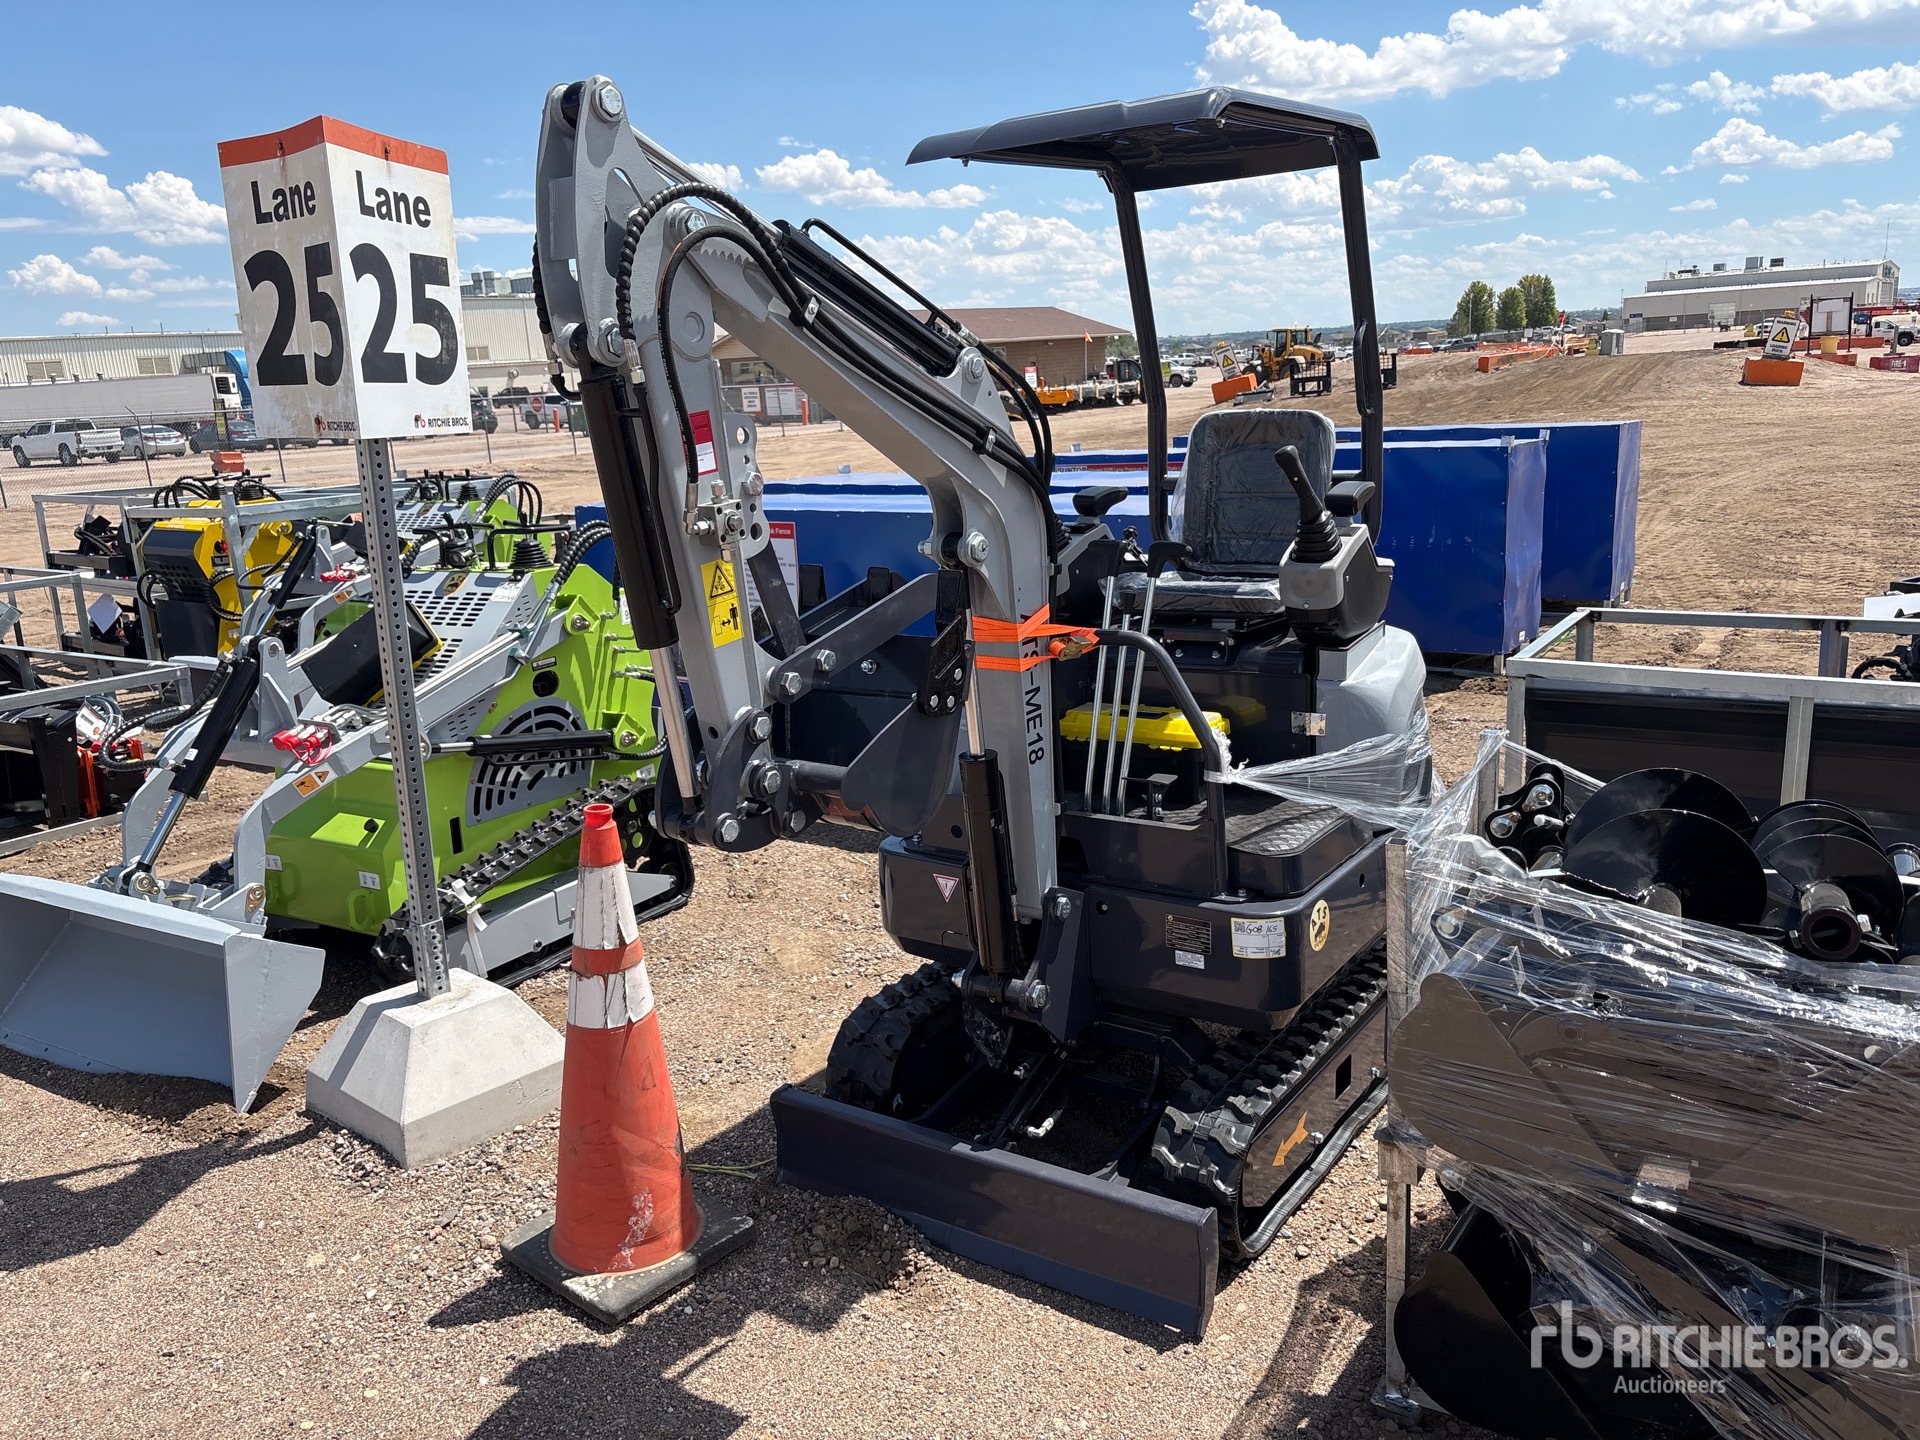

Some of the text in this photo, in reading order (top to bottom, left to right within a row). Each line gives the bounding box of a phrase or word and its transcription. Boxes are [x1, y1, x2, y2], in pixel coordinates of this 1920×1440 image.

[250, 179, 316, 225] Lane
[355, 169, 432, 228] Lane
[243, 241, 344, 387] 25
[349, 242, 459, 386] 25
[428, 417, 451, 428] RITCHIE
[775, 527, 792, 535] Fence
